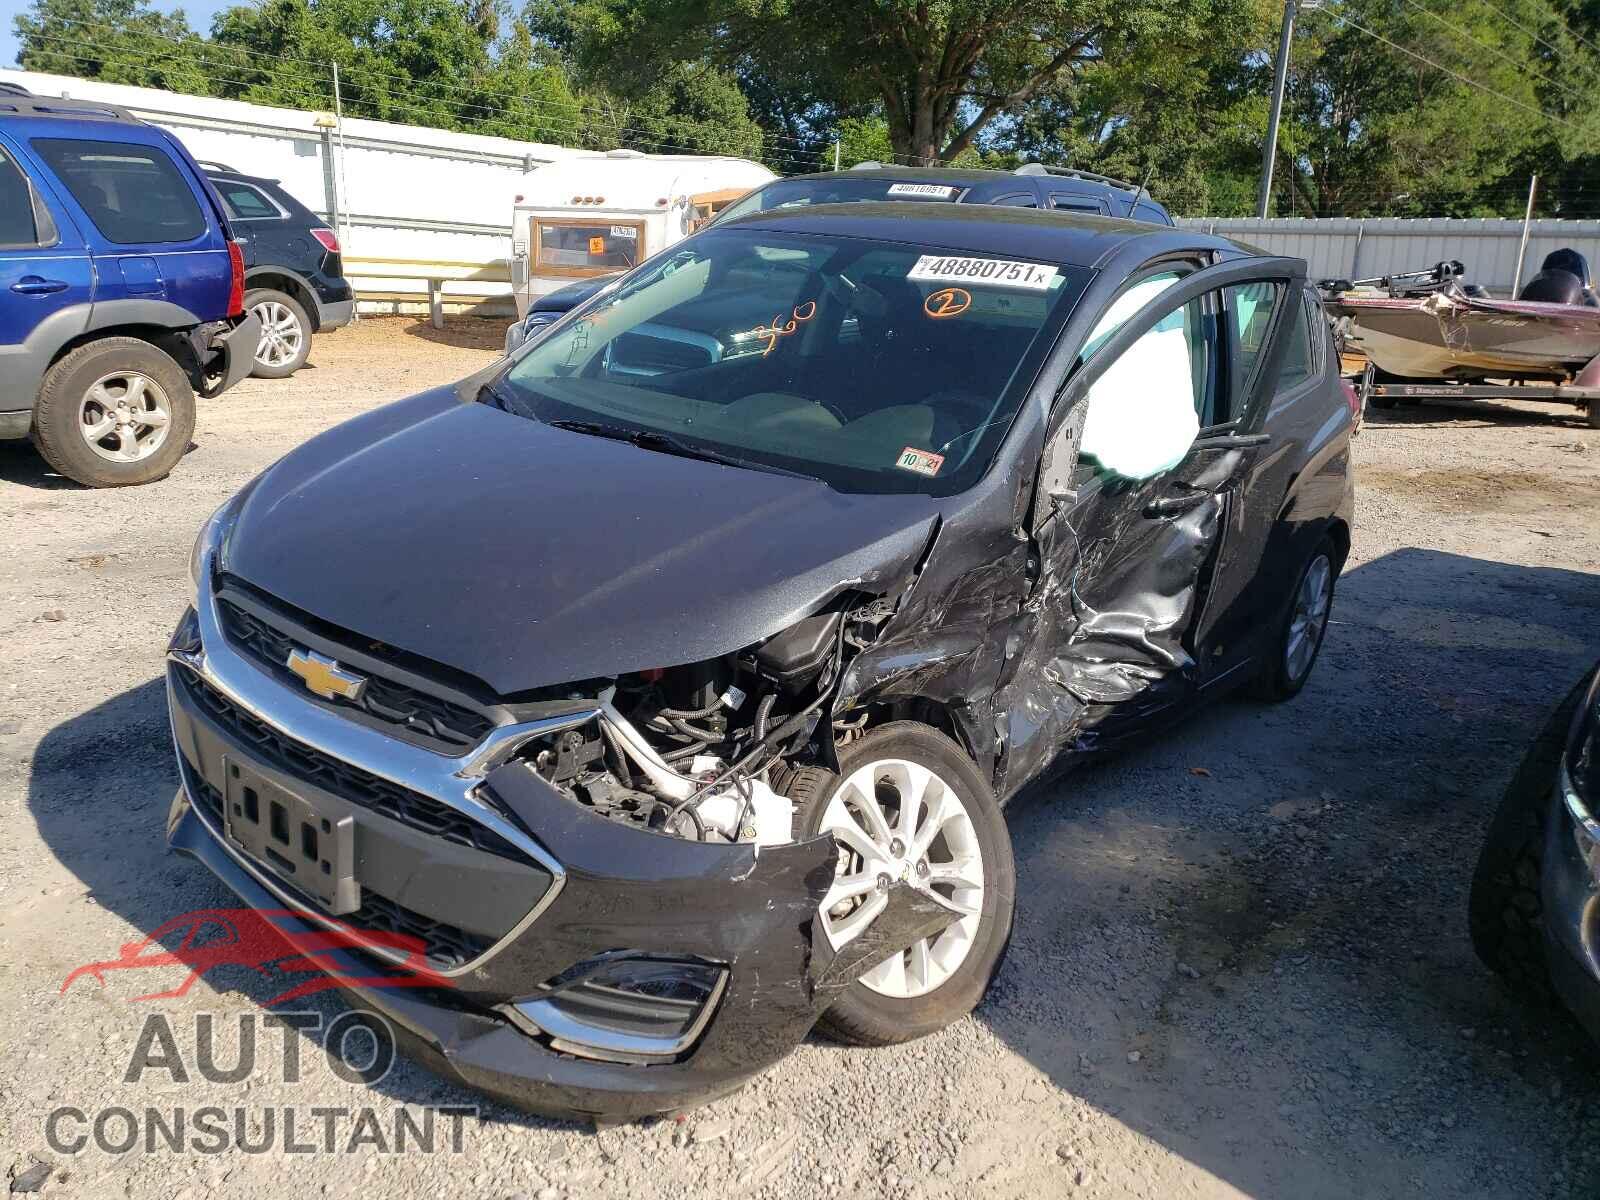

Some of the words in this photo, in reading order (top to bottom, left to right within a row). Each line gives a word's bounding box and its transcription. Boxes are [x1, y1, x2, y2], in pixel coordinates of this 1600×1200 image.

[928, 257, 1036, 282] 48880751
[932, 291, 965, 314] 2
[903, 453, 917, 466] 10
